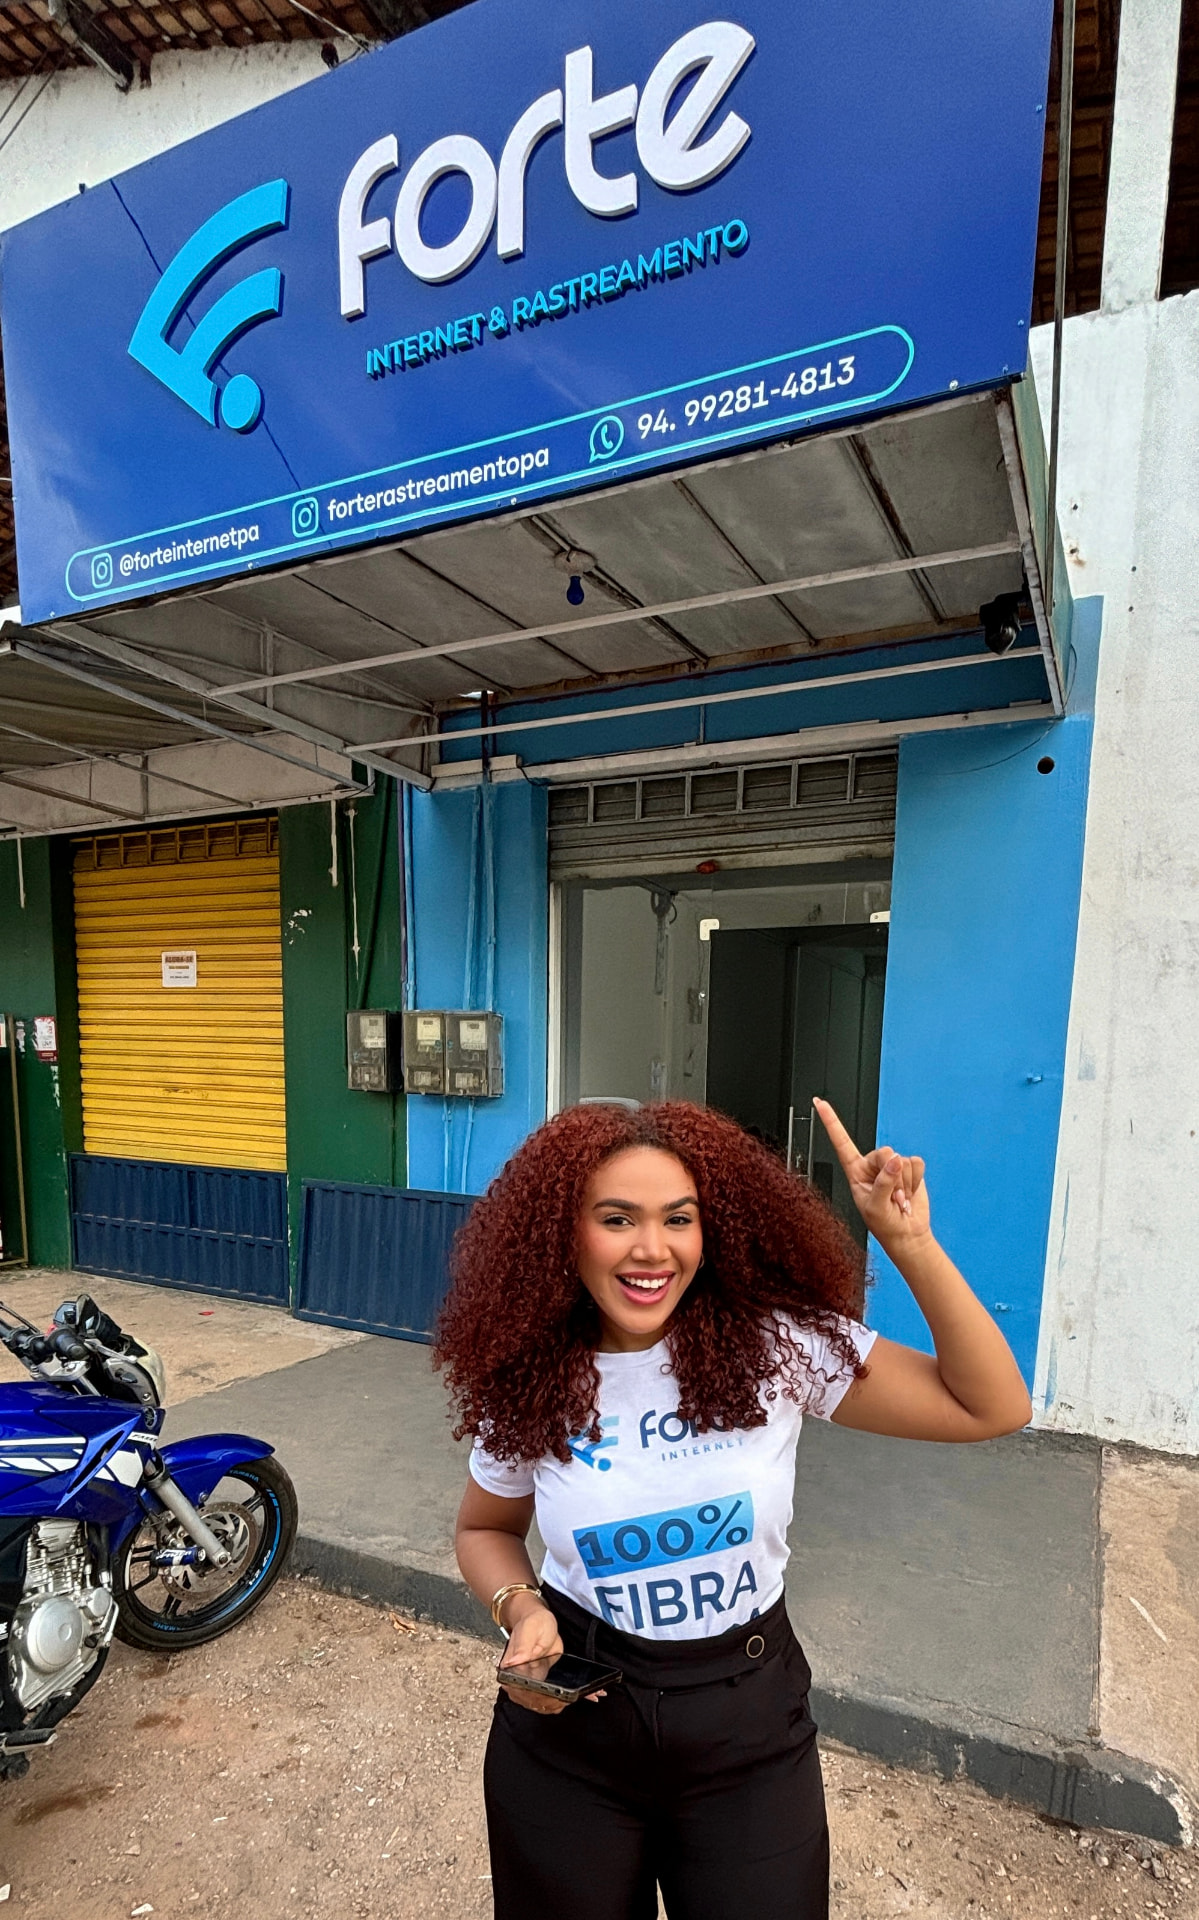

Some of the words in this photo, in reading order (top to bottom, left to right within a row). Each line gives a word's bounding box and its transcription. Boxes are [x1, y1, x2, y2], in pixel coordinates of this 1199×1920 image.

[339, 20, 756, 319] forte
[366, 313, 486, 376] INTERNET
[488, 306, 509, 336] &
[512, 219, 749, 326] RASTREAMENTO
[637, 408, 677, 440] 94.
[684, 355, 856, 427] 99281-4813
[327, 448, 550, 521] forterastreamentopa
[119, 524, 260, 577] @forteinternetpa
[661, 1437, 744, 1462] INTERNET
[577, 1499, 748, 1568] 100%
[593, 1560, 758, 1630] FIBRA
